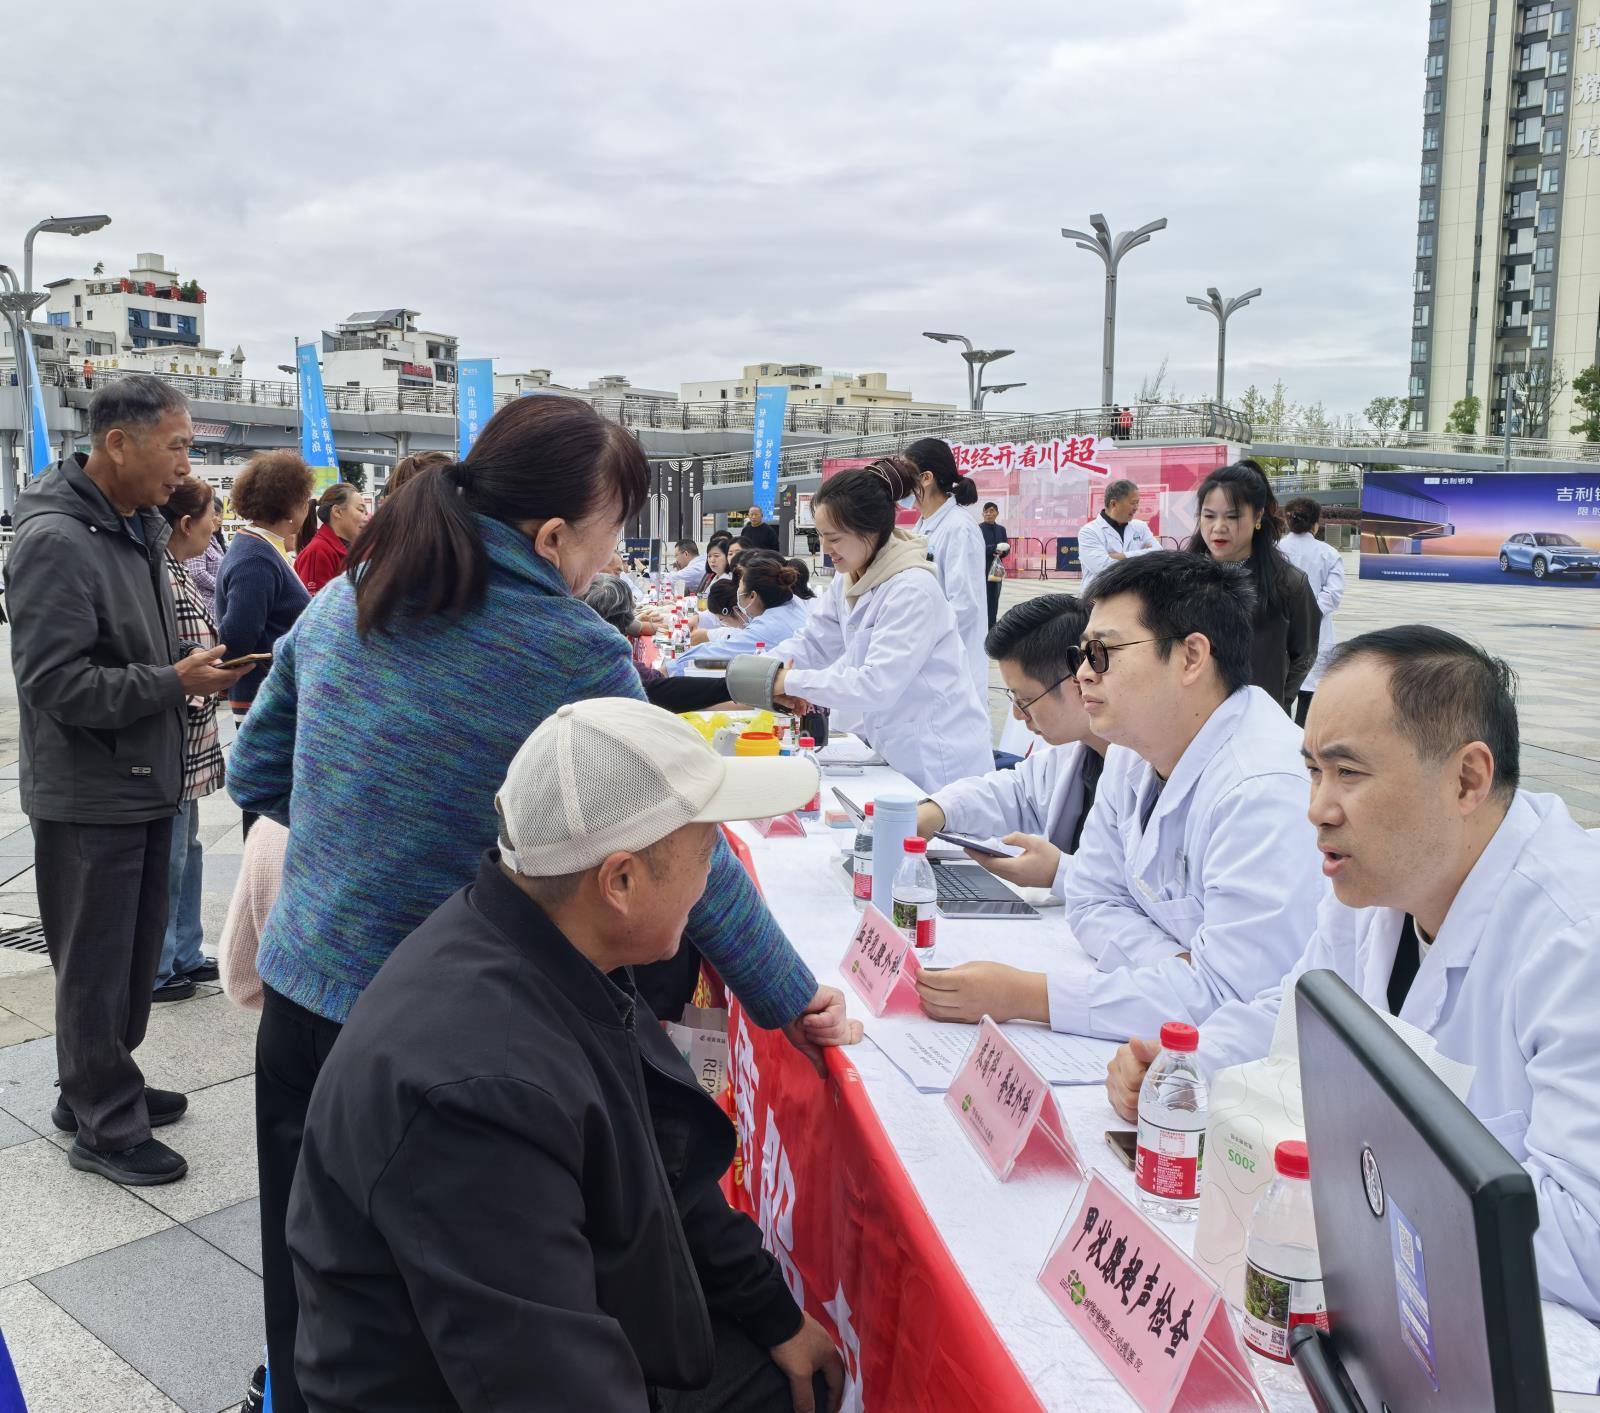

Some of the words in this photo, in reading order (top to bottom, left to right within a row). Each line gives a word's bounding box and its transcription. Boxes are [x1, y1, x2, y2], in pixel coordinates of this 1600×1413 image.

[1072, 1206, 1194, 1359] 甲状腺超声检查
